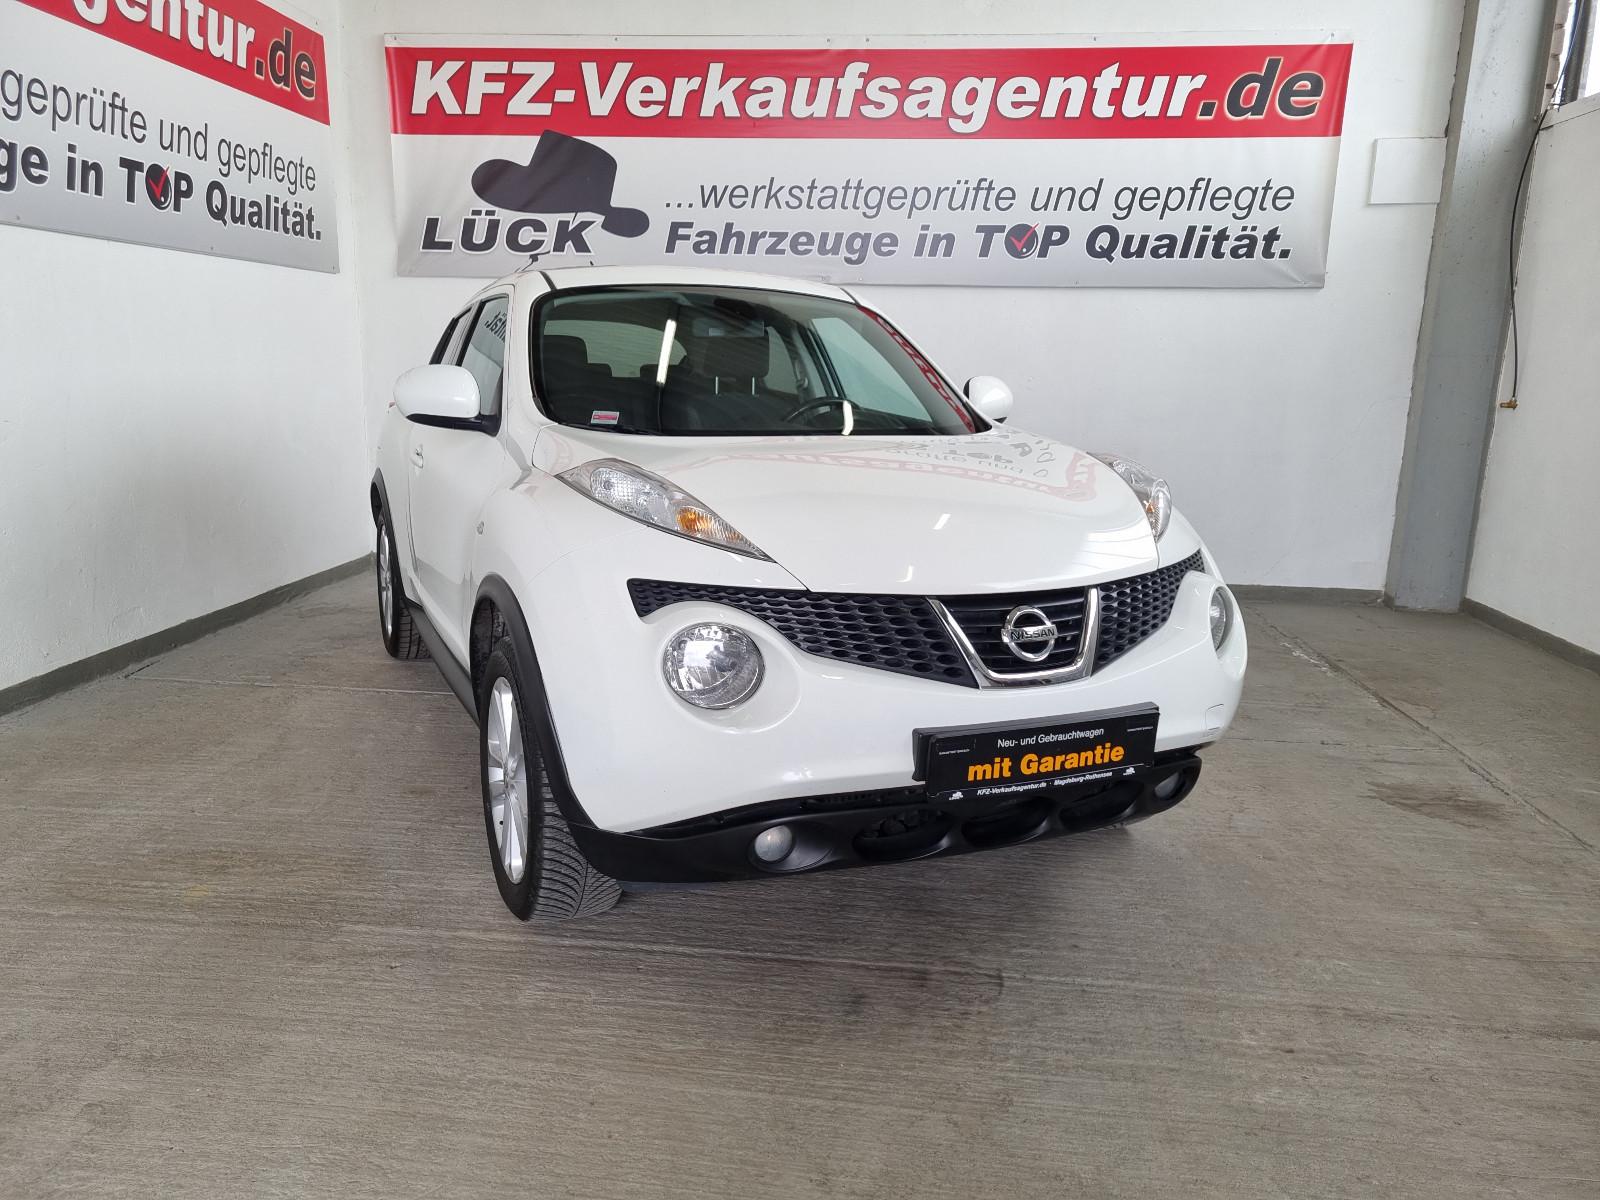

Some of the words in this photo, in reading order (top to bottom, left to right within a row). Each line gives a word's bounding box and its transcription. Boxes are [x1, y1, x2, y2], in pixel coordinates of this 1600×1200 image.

[411, 57, 1325, 134] KFZ-Verkaufsagentur.de
[159, 119, 208, 161] und
[217, 138, 316, 195] gepflegte
[66, 142, 104, 197] in
[119, 156, 194, 212] TOP
[206, 180, 322, 241] Qualität.
[1031, 178, 1103, 212] und
[1112, 178, 1295, 219] gepflegte
[421, 209, 597, 253] LÜCK
[665, 221, 899, 265] Fahrzeuge
[914, 225, 955, 258] in
[976, 222, 1070, 259] TOP
[1085, 225, 1292, 263] Qualität.
[1010, 628, 1055, 640] NISSAN
[998, 738, 1018, 749] Neu-
[1020, 735, 1037, 746] und
[1038, 728, 1104, 744] Gebrauchtwagen
[967, 757, 1012, 782] mit
[1020, 742, 1125, 775] Garantie
